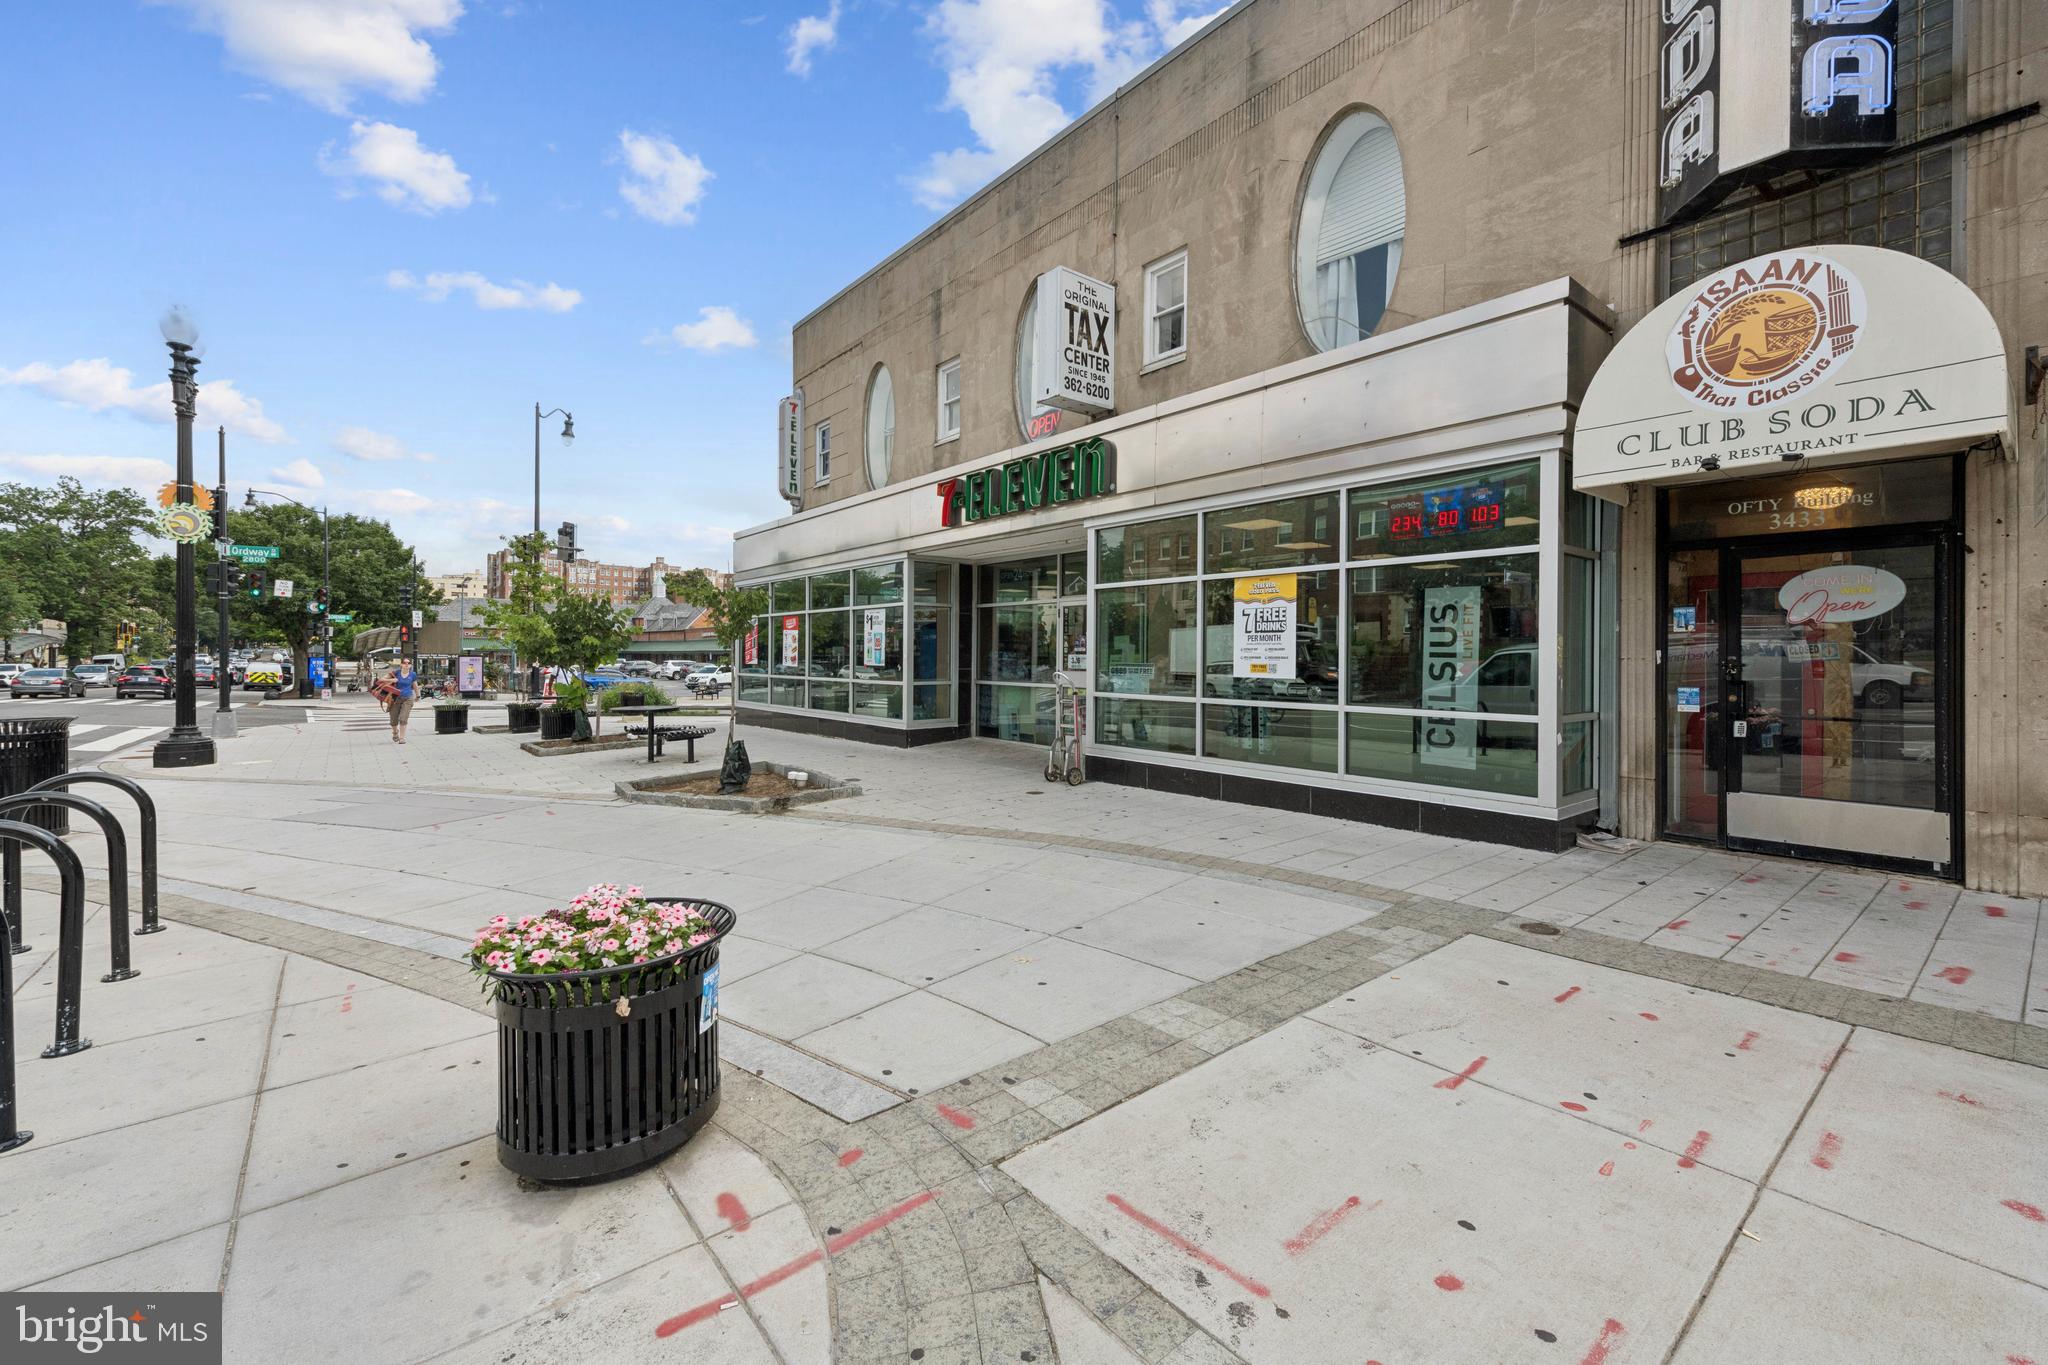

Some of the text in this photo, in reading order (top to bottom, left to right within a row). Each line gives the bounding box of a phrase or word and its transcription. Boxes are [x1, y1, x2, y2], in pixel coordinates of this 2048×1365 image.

[1078, 281, 1097, 297] THE
[1694, 258, 1822, 311] ISAAN
[1064, 289, 1110, 313] ORIGINAL
[1064, 302, 1109, 356] TAX
[1064, 347, 1110, 374] CENTER
[1068, 366, 1106, 383] SINCE 1945
[1695, 358, 1831, 407] Thai Classic
[1064, 376, 1110, 400] 362-6200
[1028, 412, 1062, 438] OPEN
[1617, 388, 1936, 456] CLUB SODA
[1671, 455, 1703, 468] BAR
[1729, 432, 1858, 461] RESTAURANT
[1728, 491, 1874, 515] OFTY Building
[1769, 511, 1826, 530] 3433
[231, 547, 270, 557] Ordway
[1463, 604, 1474, 626] FIT
[1787, 589, 1877, 624] Open
[1242, 607, 1287, 633] 7 FREE
[1256, 621, 1288, 633] DRINKS
[1260, 634, 1281, 642] MONTH
[1462, 631, 1474, 661] LIVE
[1789, 644, 1819, 656] CLOSED
[1426, 602, 1459, 748] CELSIUS
